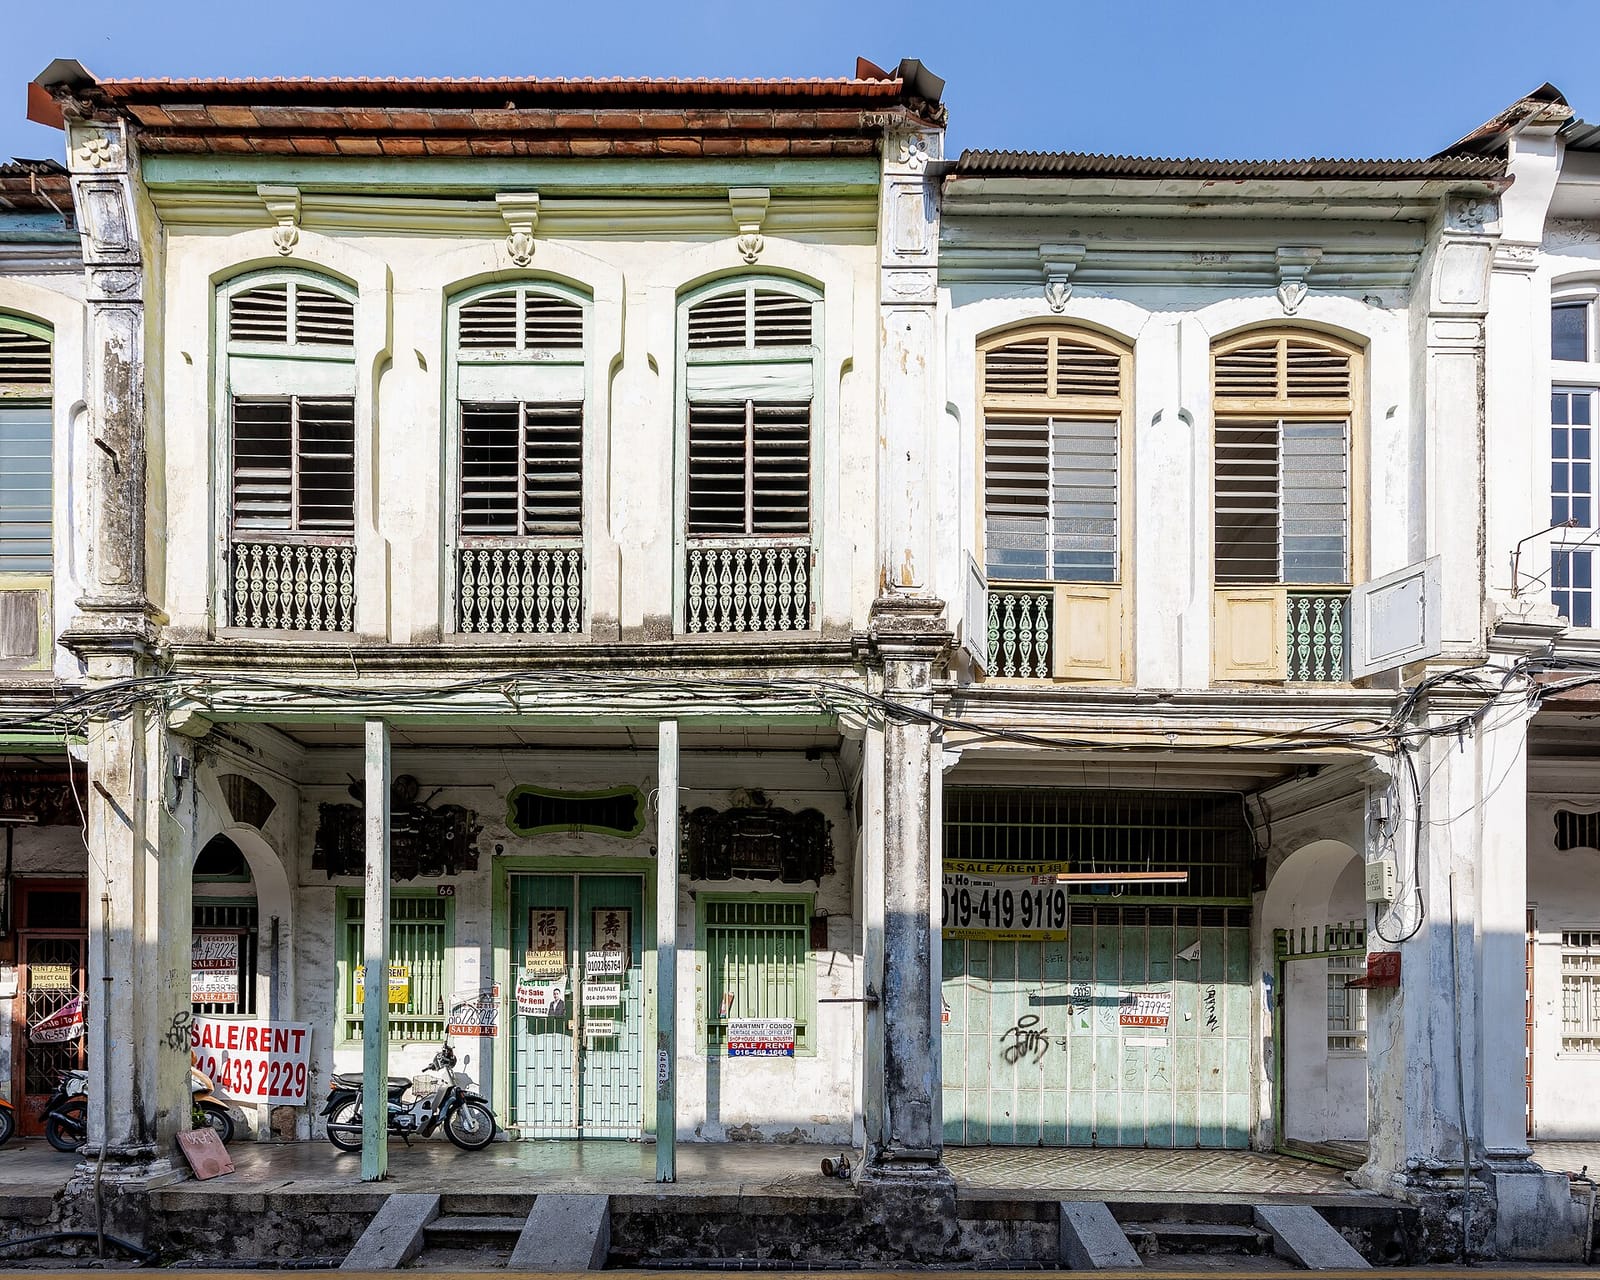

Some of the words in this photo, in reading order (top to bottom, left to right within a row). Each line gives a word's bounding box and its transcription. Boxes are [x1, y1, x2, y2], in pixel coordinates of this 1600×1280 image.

[956, 863, 1046, 873] SALE/RENT
[955, 874, 969, 886] Ho
[440, 886, 453, 895] 66
[1020, 889, 1066, 928] 9119
[192, 960, 237, 968] SALE/LET
[1122, 1016, 1167, 1024] SALE/LET
[451, 1026, 496, 1034] SALE/LET
[191, 1022, 306, 1054] SALE/RENT
[257, 1060, 306, 1098] 2229
